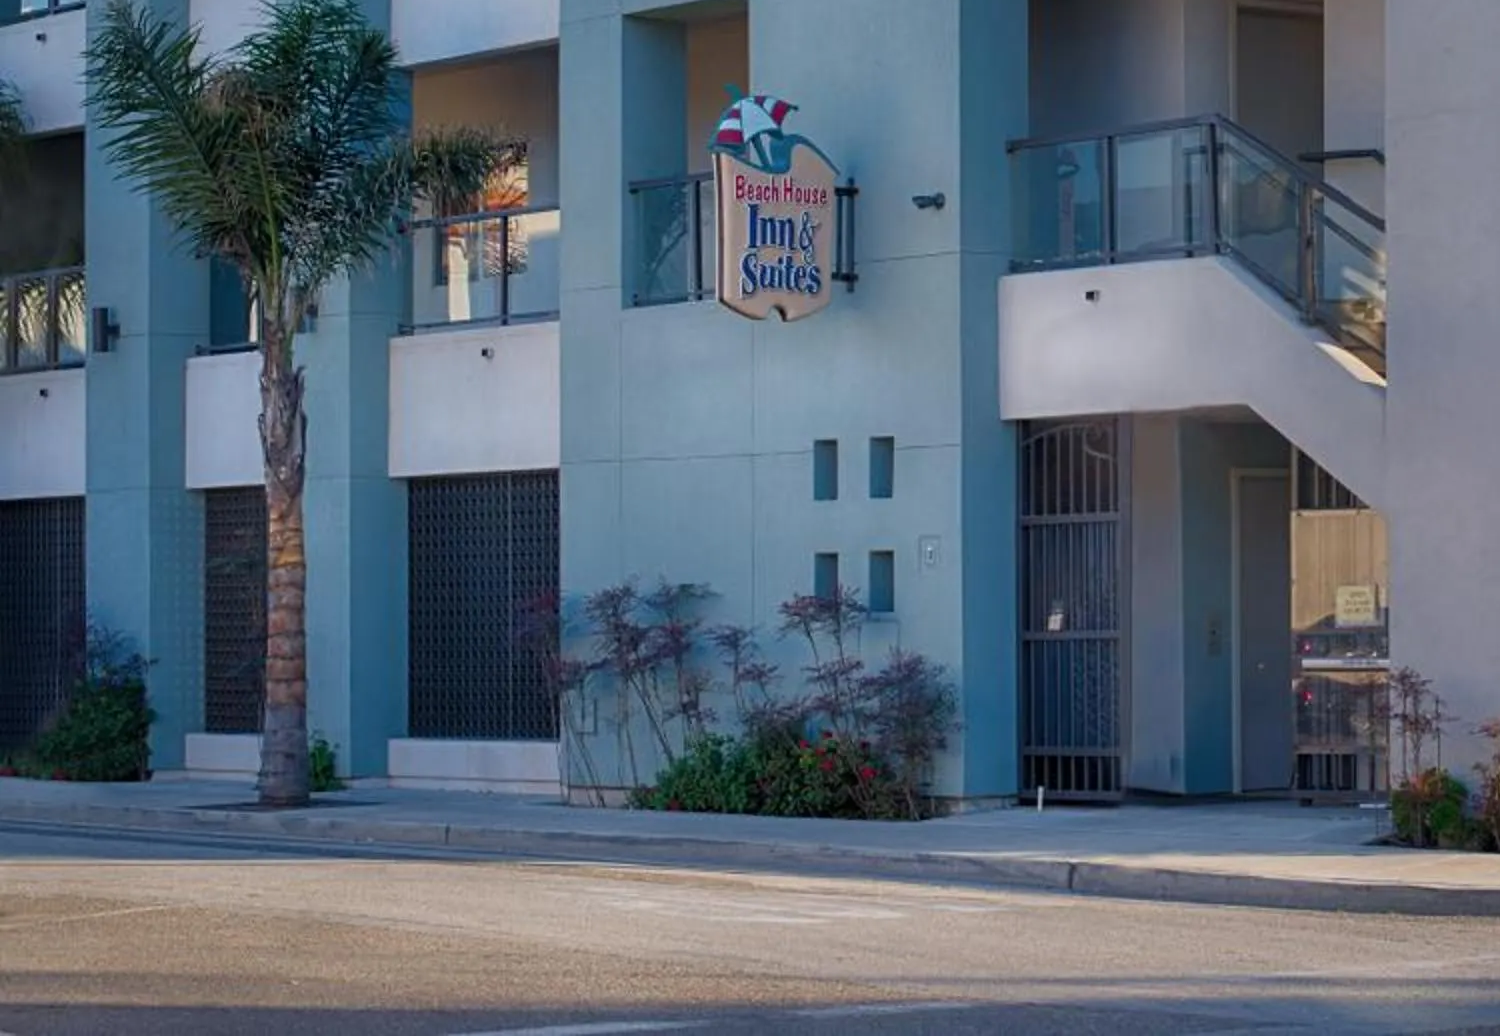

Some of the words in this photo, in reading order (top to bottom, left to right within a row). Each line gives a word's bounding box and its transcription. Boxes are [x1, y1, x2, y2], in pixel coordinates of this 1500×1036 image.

[735, 175, 778, 202] Beach
[783, 176, 828, 205] House
[748, 204, 795, 249] Inn
[799, 212, 821, 264] &
[741, 252, 822, 297] Suites
